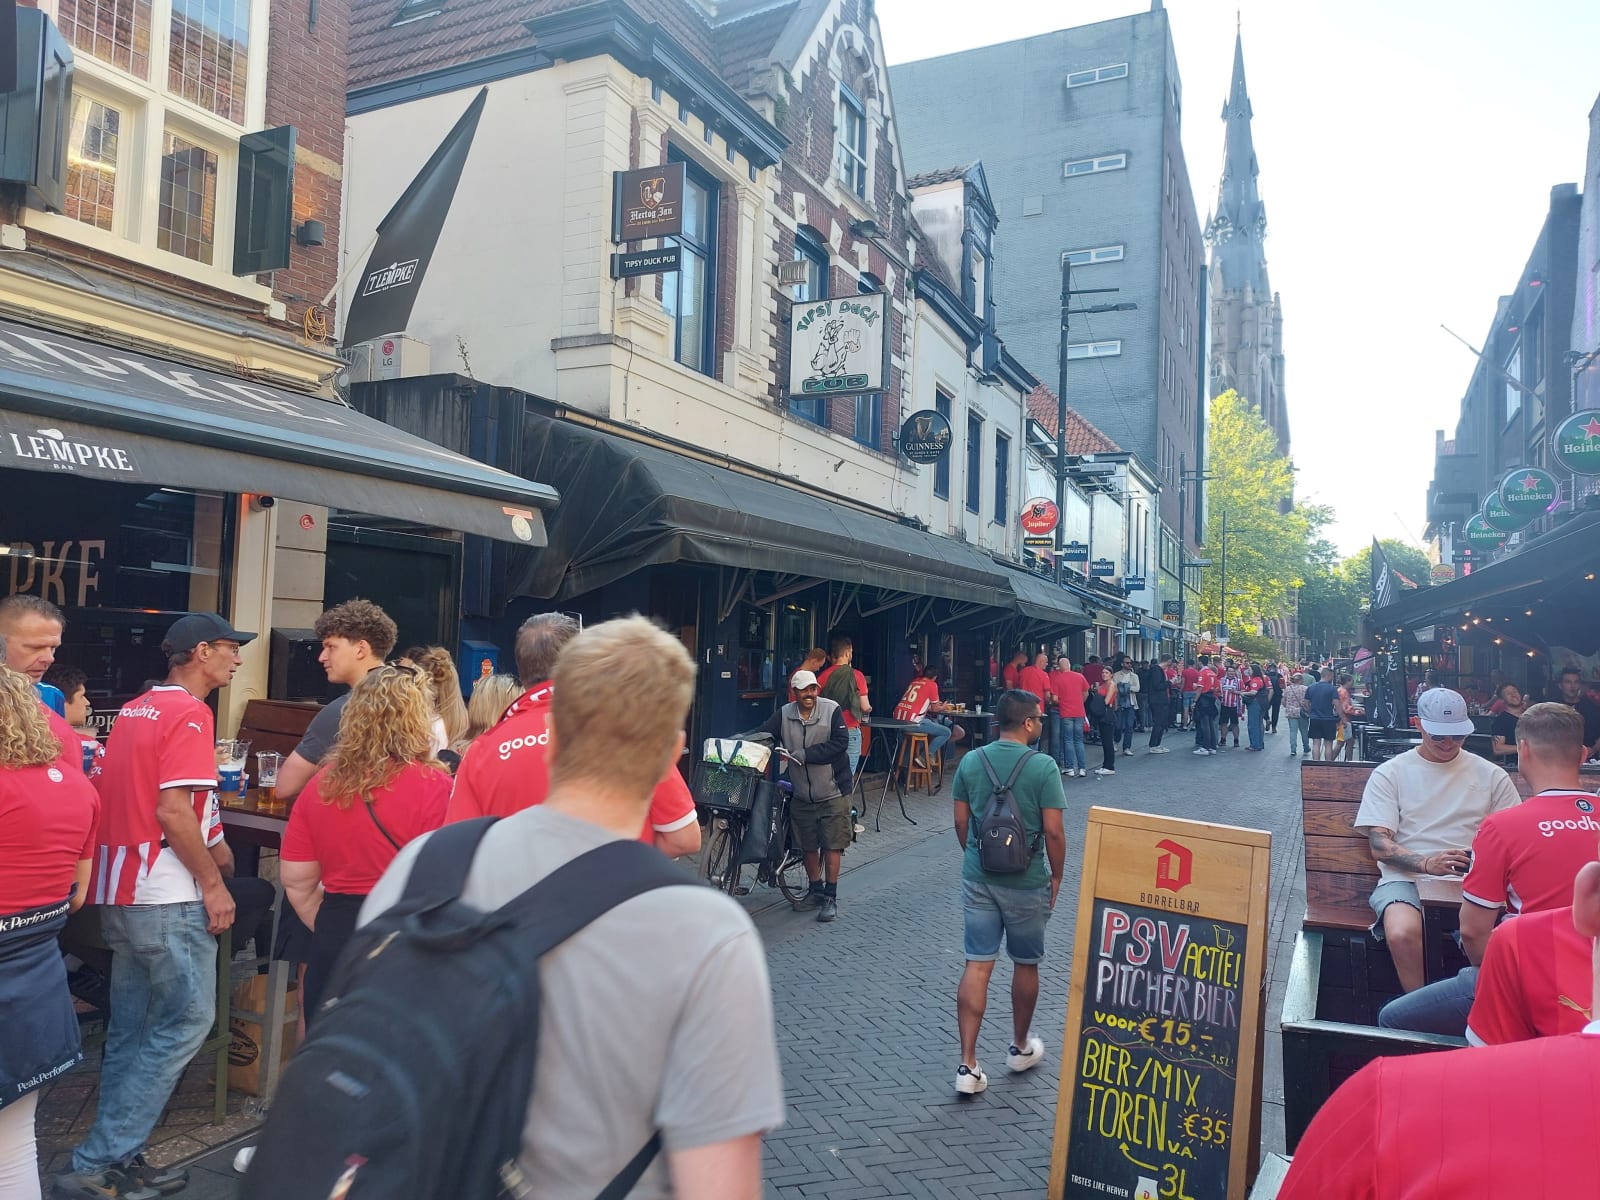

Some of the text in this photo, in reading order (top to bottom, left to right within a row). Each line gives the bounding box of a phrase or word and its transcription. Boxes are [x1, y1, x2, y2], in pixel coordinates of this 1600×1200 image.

[630, 206, 673, 221] Hertog Jan
[625, 255, 676, 268] TIPSY DUCK PUB
[375, 264, 415, 289] LEMPKE
[796, 300, 880, 332] TIPSY DUCK
[382, 357, 393, 366] LG
[805, 377, 866, 390] PUB
[9, 432, 134, 471] LEMPKE
[905, 442, 945, 451] GUINNESS
[53, 463, 74, 471] BAR
[1507, 493, 1553, 502] Heineken
[1027, 520, 1051, 529] Jupiler
[1470, 531, 1506, 539] Heineken
[1092, 563, 1114, 571] Bavaria
[1140, 892, 1200, 913] BORRELBAR
[1099, 907, 1241, 989] PSV ACTIE!
[1096, 959, 1237, 1028] PITCHER BIER
[17, 1076, 41, 1093] Peak
[1082, 1082, 1168, 1152] TOREN
[1183, 1112, 1227, 1144] €35
[1071, 1174, 1129, 1198] TASTES LIKE HEAVEN
[1159, 1162, 1195, 1200] 3L
